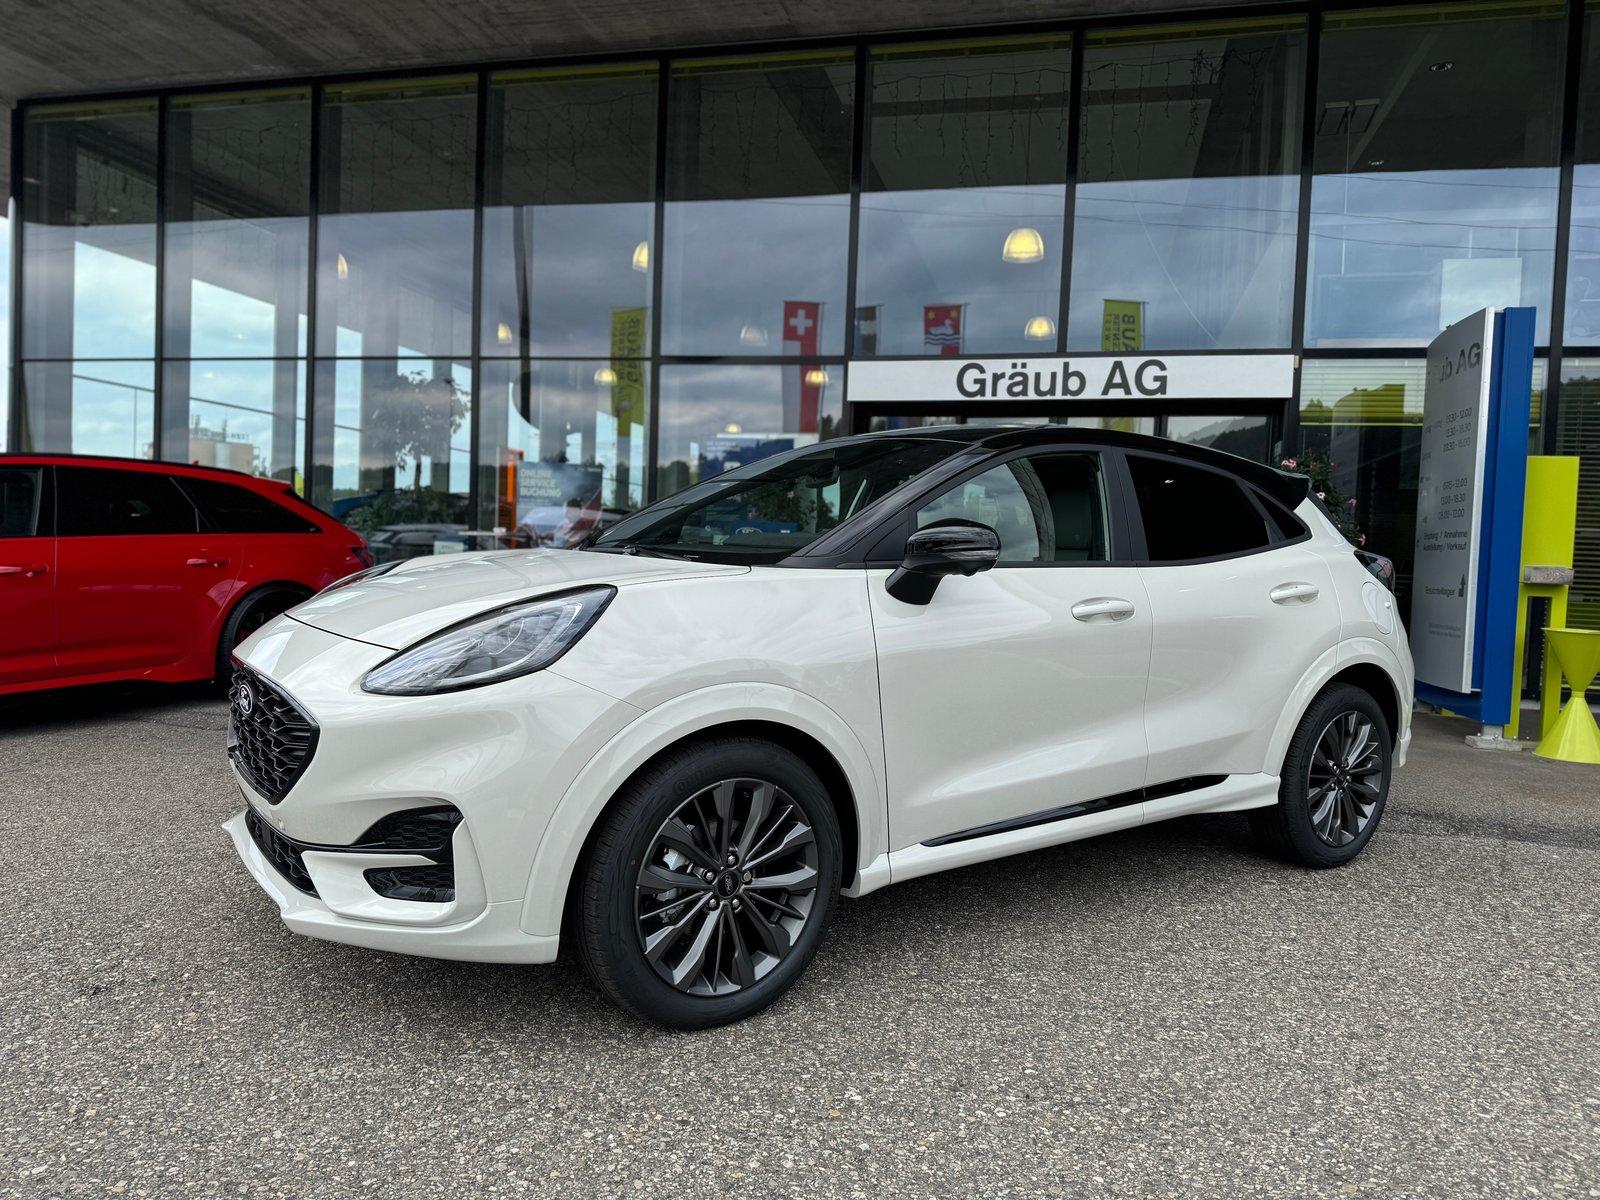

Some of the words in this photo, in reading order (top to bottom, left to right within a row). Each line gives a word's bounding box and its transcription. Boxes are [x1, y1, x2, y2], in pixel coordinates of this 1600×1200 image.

[1455, 342, 1481, 375] AG
[956, 362, 1087, 398] Gräub
[1100, 359, 1168, 396] AG
[520, 469, 552, 479] ONLINE
[521, 478, 556, 488] SERVICE
[520, 487, 561, 497] BUCHUNG
